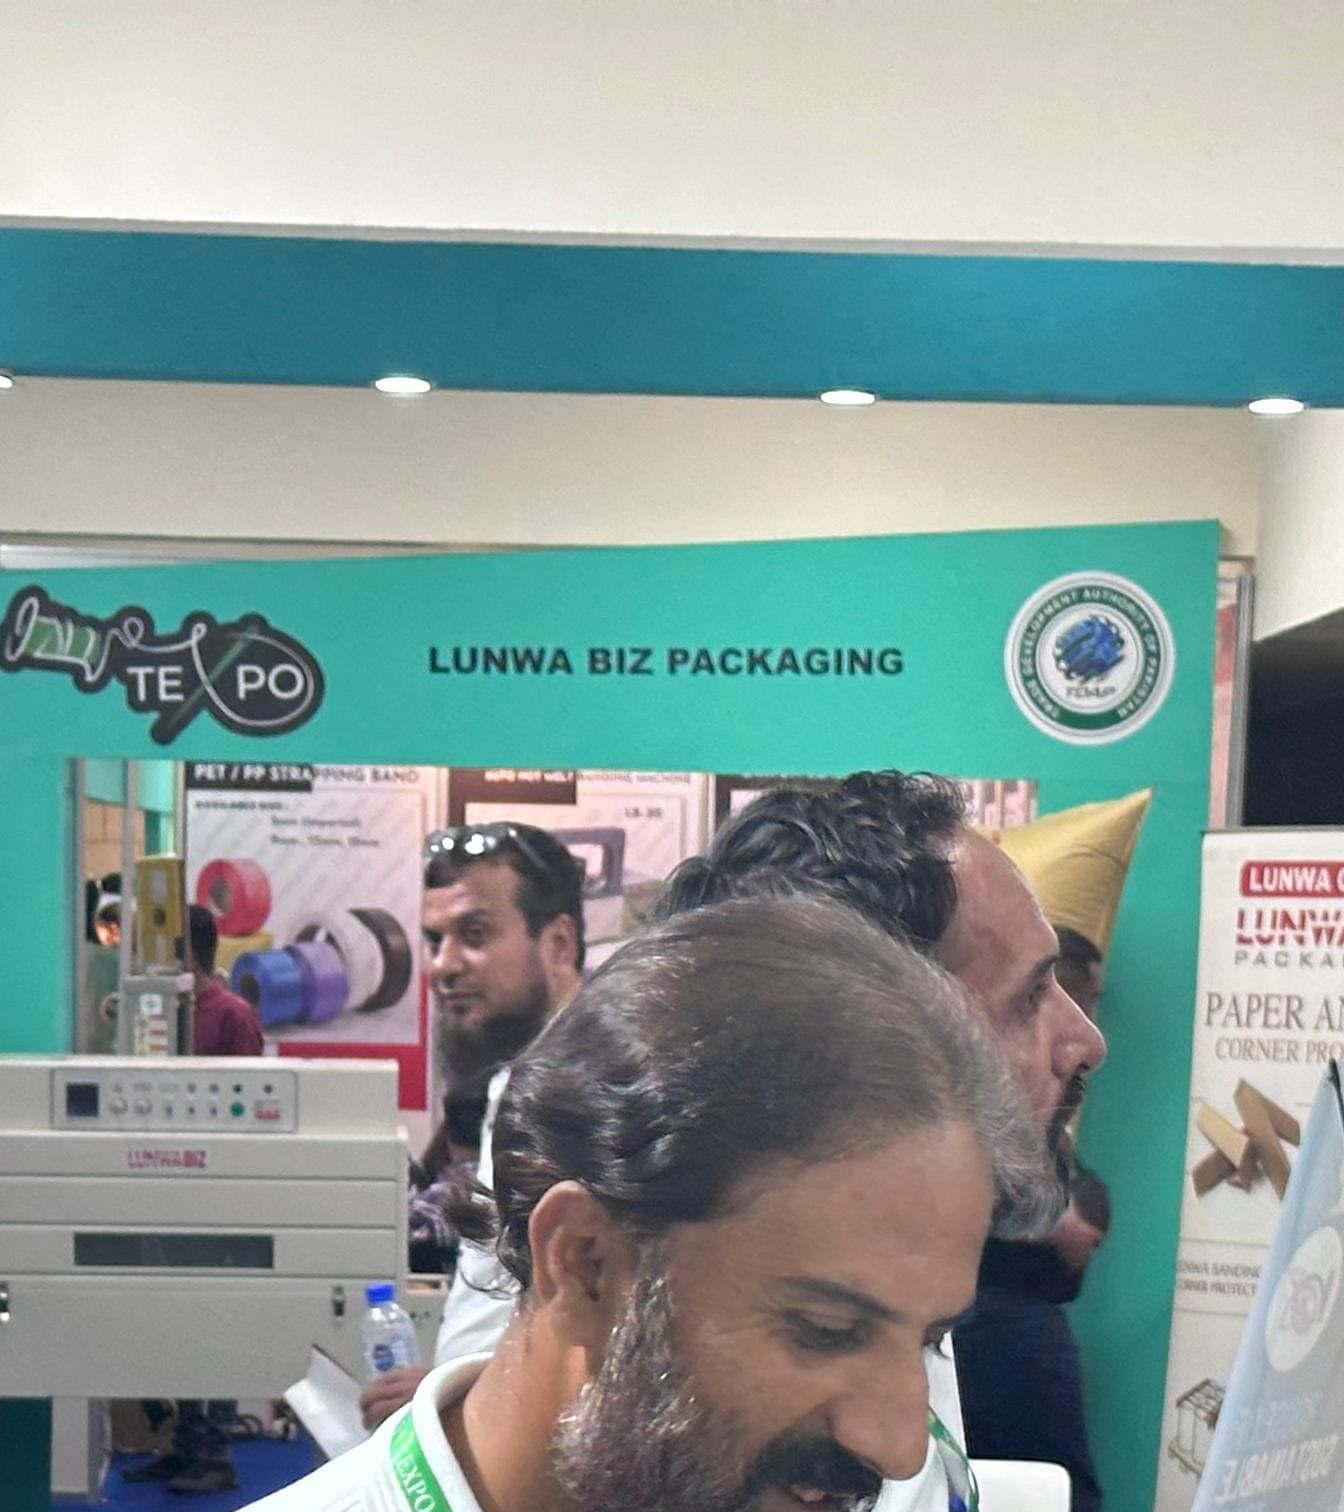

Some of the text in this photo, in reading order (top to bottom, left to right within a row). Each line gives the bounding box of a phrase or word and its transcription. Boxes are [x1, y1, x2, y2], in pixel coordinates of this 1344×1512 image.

[428, 646, 904, 677] LUNWA BIZ PACKAGING
[1249, 866, 1332, 893] LUNWA
[1204, 992, 1305, 1031] PAPER
[1215, 1036, 1300, 1063] CORNER
